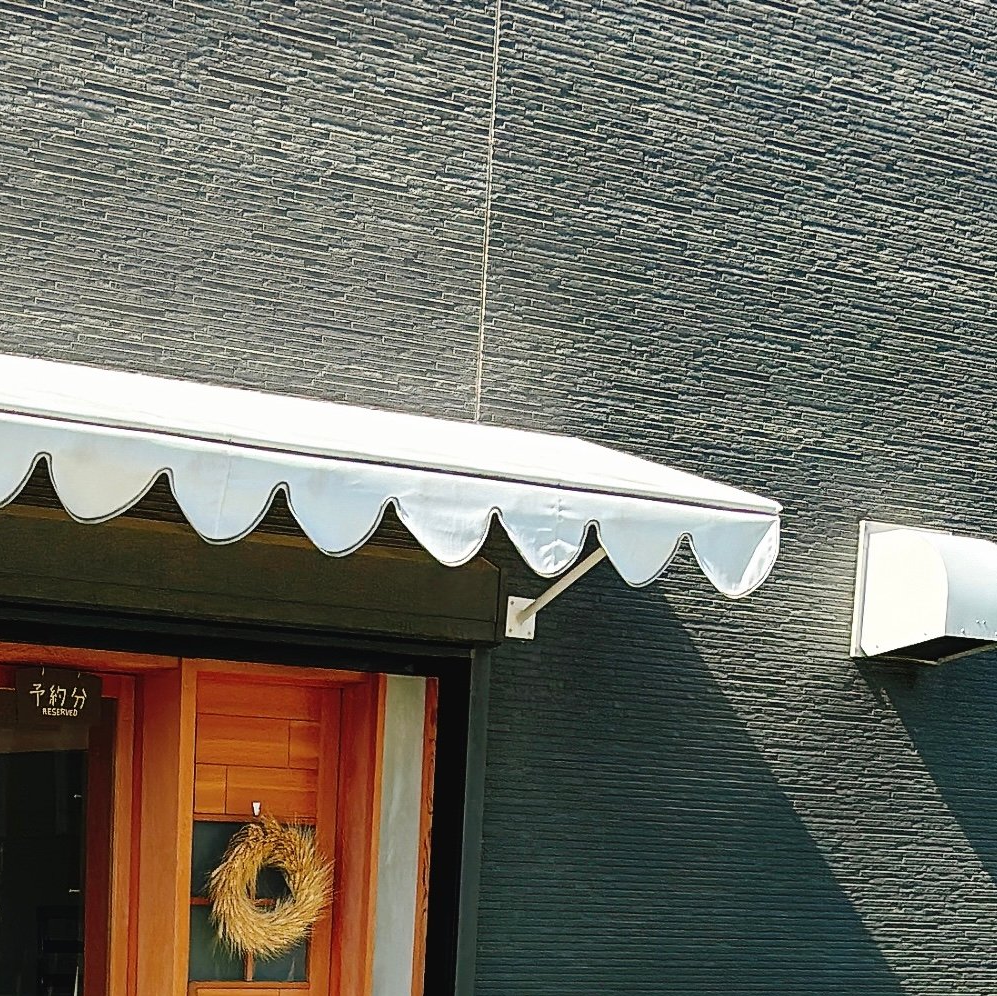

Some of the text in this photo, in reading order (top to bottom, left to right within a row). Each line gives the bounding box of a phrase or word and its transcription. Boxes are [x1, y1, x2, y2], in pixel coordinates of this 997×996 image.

[29, 683, 88, 710] 予約分
[42, 707, 78, 717] RESERVED
